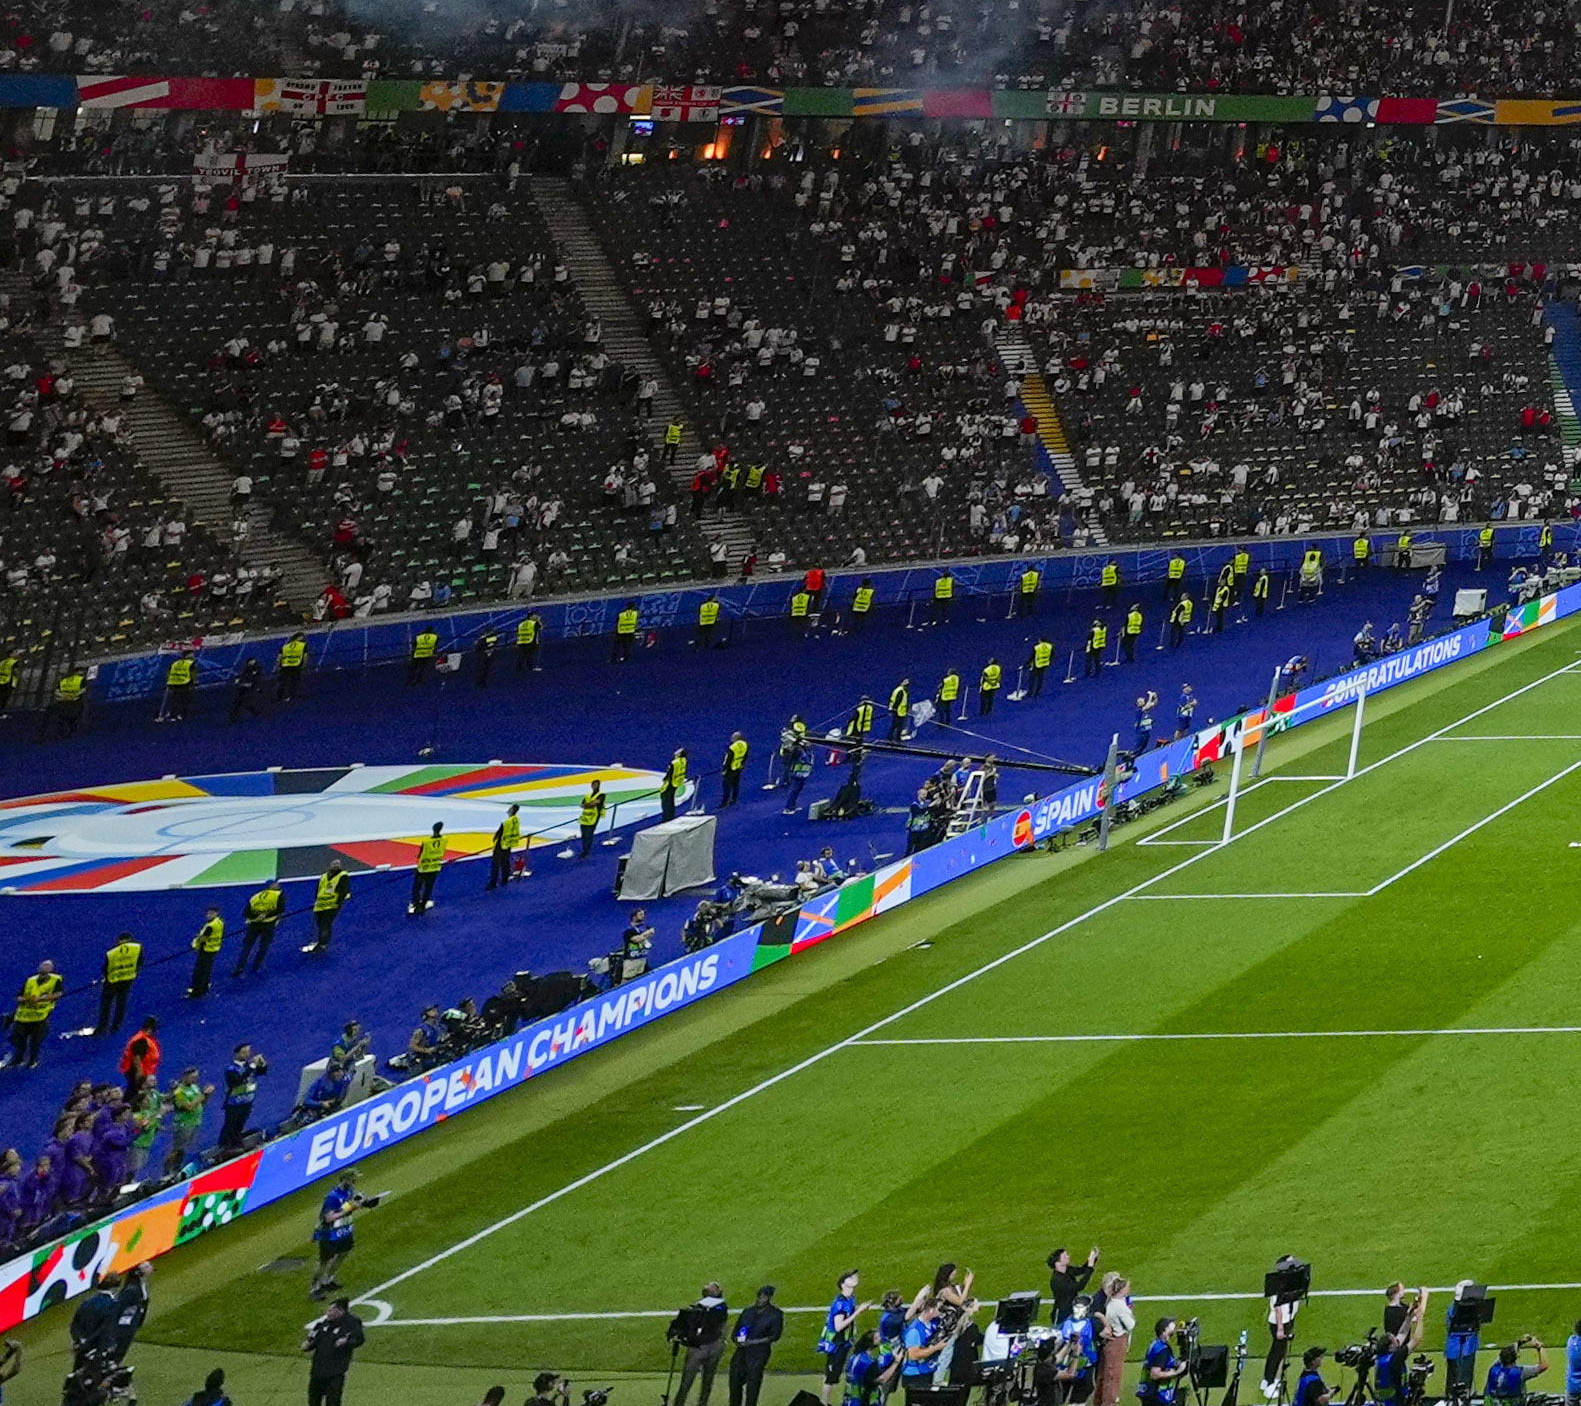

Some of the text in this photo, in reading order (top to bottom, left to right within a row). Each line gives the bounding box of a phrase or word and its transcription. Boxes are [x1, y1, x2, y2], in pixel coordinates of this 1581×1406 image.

[1100, 97, 1215, 117] BERLIN
[247, 165, 280, 175] TOWN
[1324, 635, 1462, 707] CONGRATULATIONS
[1034, 785, 1093, 836] SPAIN
[306, 953, 720, 1177] EUROPEAN CHAMPIONS
